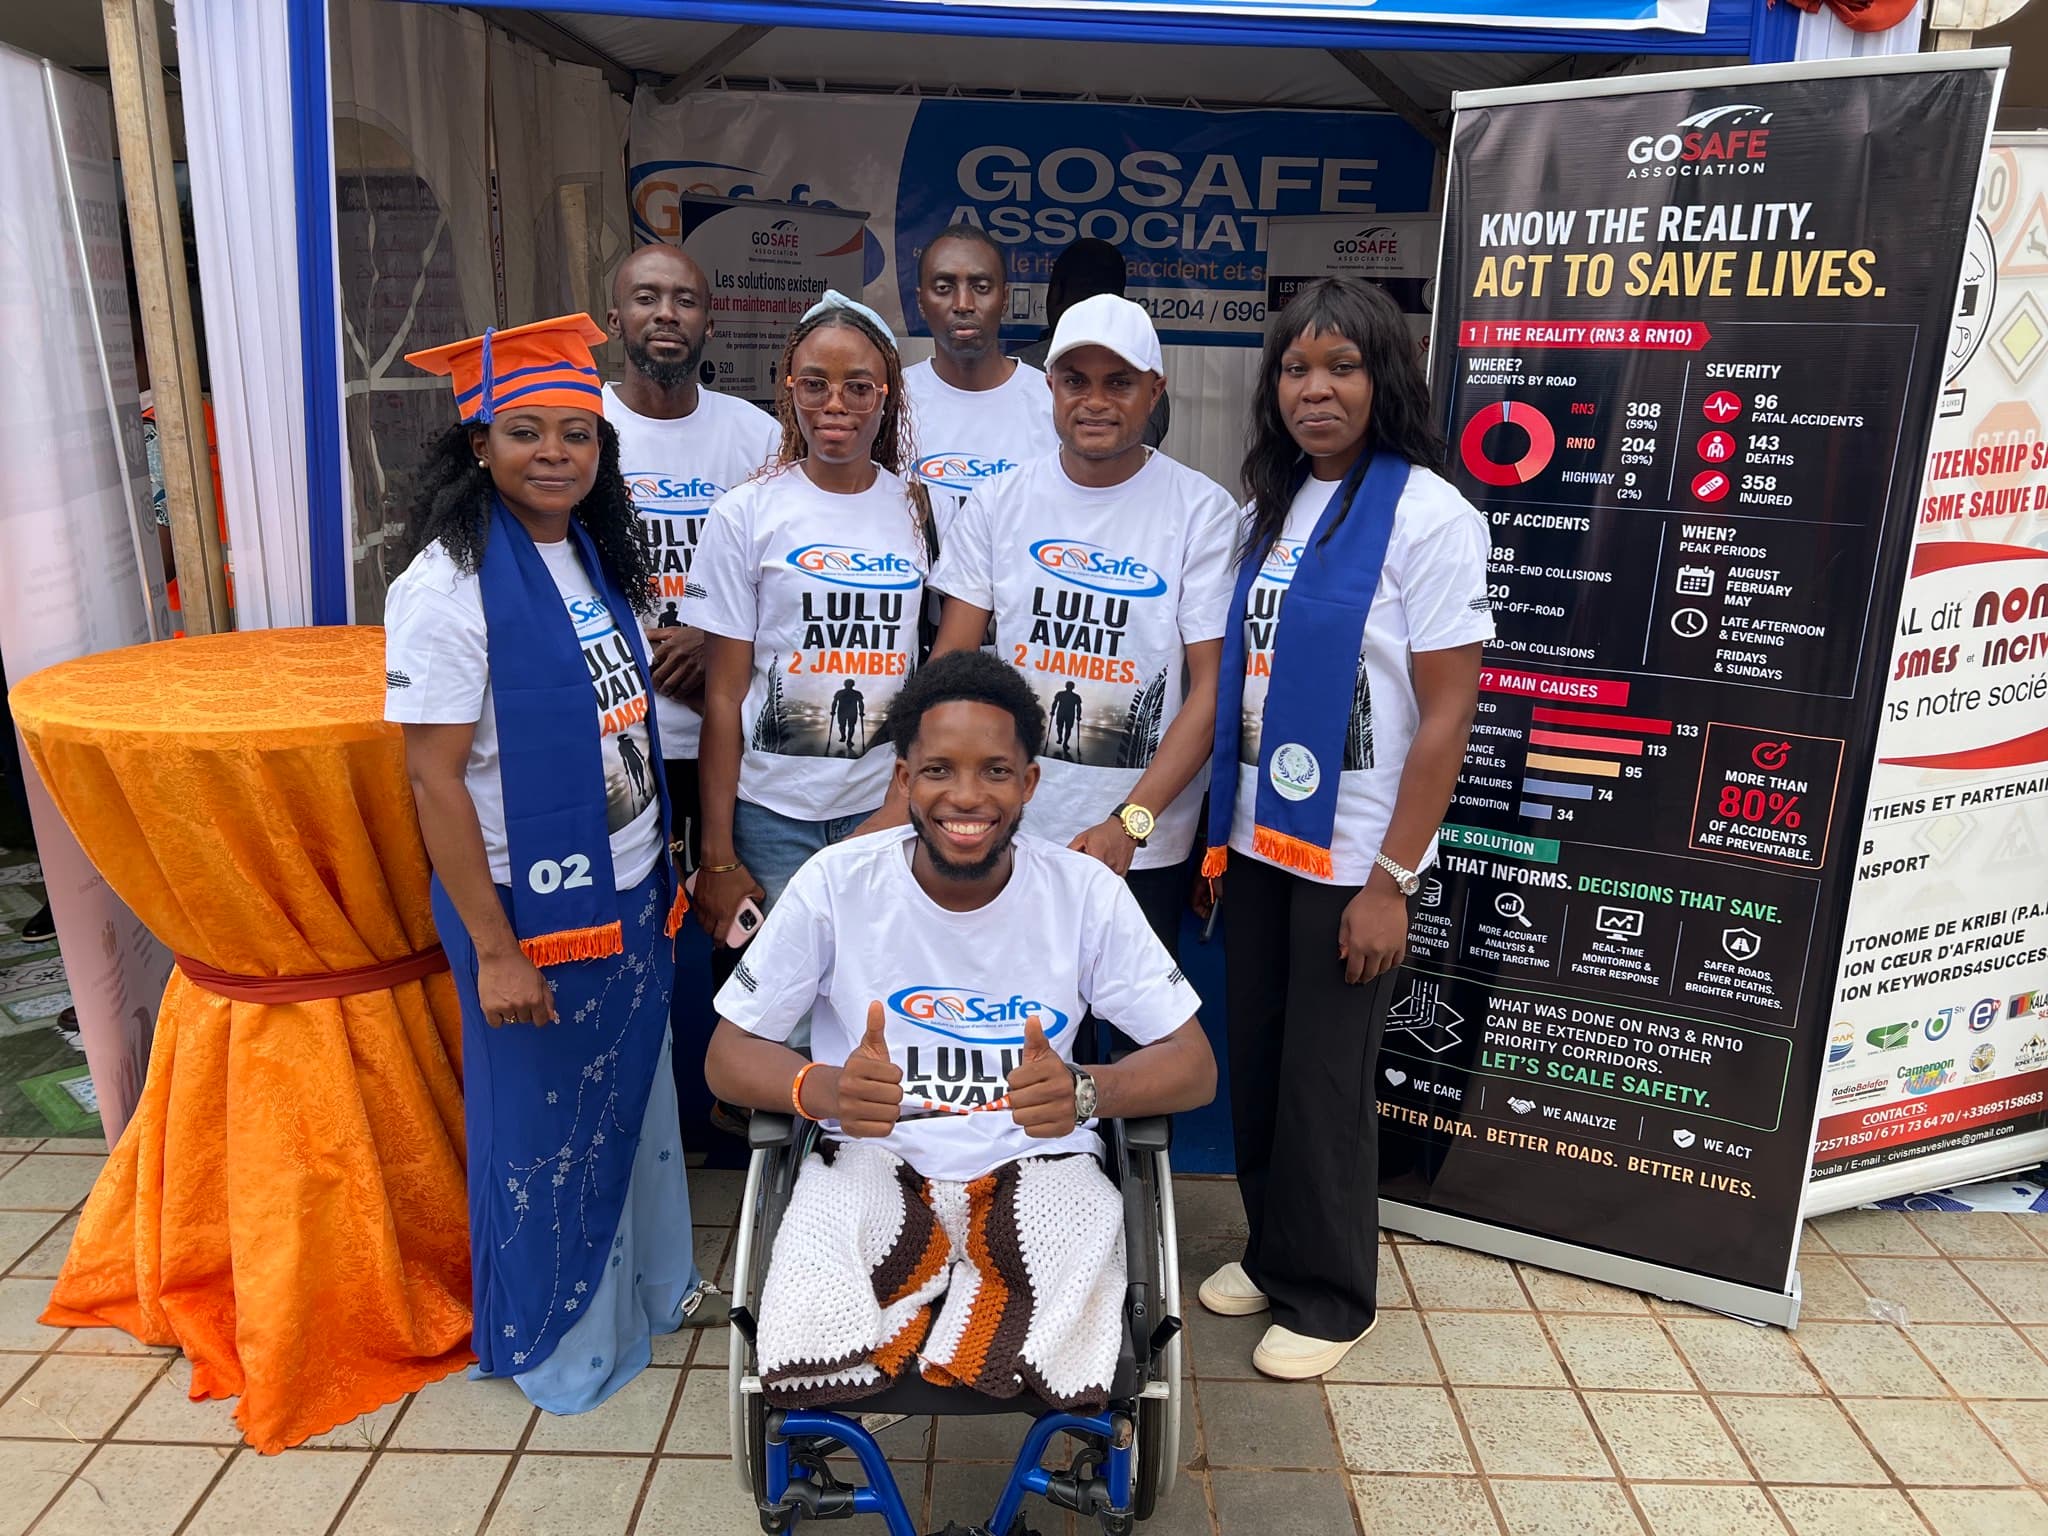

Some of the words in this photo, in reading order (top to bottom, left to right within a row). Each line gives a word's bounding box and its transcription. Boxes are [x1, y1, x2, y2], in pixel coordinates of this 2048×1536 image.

[1627, 129, 1768, 162] GOSAFE
[957, 146, 1378, 213] GOSAFE
[1627, 162, 1766, 179] ASSOCIATION
[1480, 210, 1577, 247] KNOW
[1586, 207, 1650, 244] THE
[1657, 202, 1816, 242] REALITY.
[752, 232, 798, 248] GOSAFE
[1334, 240, 1397, 253] GOSAFE
[716, 270, 734, 289] Les
[738, 272, 785, 291] solutions
[788, 275, 827, 293] existent
[1473, 255, 1553, 298] ACT
[1565, 253, 1615, 297] TO
[1625, 252, 1737, 297] SAVE
[1746, 249, 1886, 298] LIVES.
[1280, 282, 1294, 292] LES
[733, 296, 786, 313] maintenant
[789, 298, 801, 313] les
[1224, 301, 1265, 321] 696
[1496, 327, 1523, 343] THE
[1527, 327, 1585, 343] REALITY
[1590, 327, 1626, 345] (RN3
[1630, 328, 1641, 343] &
[1645, 327, 1693, 345] RN10)
[720, 362, 733, 374] 520
[1469, 358, 1522, 373] WHERE?
[1706, 363, 1781, 380] SEVERITY
[1467, 374, 1524, 386] ACCIDENTS
[1528, 376, 1542, 387] BY
[1546, 376, 1577, 388] ROAD
[1571, 403, 1595, 415] RN3
[1626, 403, 1661, 418] 308
[1754, 395, 1778, 410] 96
[1626, 418, 1657, 431] (59%)
[1752, 412, 1788, 426] FATAL
[1792, 413, 1864, 429] ACCIDENTS
[1567, 437, 1595, 450] RN10
[1621, 437, 1656, 453] 204
[1748, 436, 1779, 451] 143
[1621, 453, 1653, 466] (39%)
[1745, 453, 1794, 467] DEATHS
[1562, 471, 1616, 486] HIGHWAY
[1741, 474, 1777, 491] 358
[1739, 492, 1793, 507] INJURED
[1969, 486, 2031, 518] SAUVE
[1682, 525, 1736, 542] WHEN?
[1680, 542, 1711, 555] PEAK
[1713, 545, 1767, 559] PERIODS
[1486, 563, 1542, 576] REAR-END
[1546, 568, 1612, 583] COLLISIONS
[1728, 567, 1780, 582] AUGUST
[1726, 581, 1792, 598] FEBRUARY
[802, 592, 902, 622] LULU
[1032, 586, 1130, 629] LULU
[1931, 602, 1962, 631] dit
[802, 624, 901, 649] AVAIT
[1029, 619, 1126, 656] AVAIT
[1721, 617, 1749, 629] LATE
[1752, 619, 1825, 637] AFTERNOON
[1731, 631, 1784, 647] EVENING
[788, 652, 802, 674] 2
[810, 651, 907, 675] JAMBES
[1014, 644, 1027, 667] 2
[1035, 649, 1140, 684] JAMBES.
[1716, 649, 1767, 665] FRIDAYS
[1894, 644, 1960, 681] SMES
[1966, 654, 1975, 663] et
[1726, 664, 1783, 681] SUNDAYS
[1500, 675, 1536, 691] MAIN
[1540, 680, 1598, 698] CAUSES
[1916, 688, 1980, 717] notre
[1725, 770, 1765, 786] MORE
[1769, 775, 1808, 793] THAN
[1718, 786, 1800, 829] 80%
[1464, 832, 1535, 855] SOLUTION
[1709, 819, 1727, 832] OF
[1730, 821, 1807, 846] ACCIDENTS
[1700, 833, 1724, 846] ARE
[1726, 836, 1813, 861] PREVENTABLE.
[527, 853, 593, 895] 02
[1858, 855, 1929, 881] NSPORT
[1447, 855, 1488, 875] THAT
[1492, 863, 1572, 890] INFORMS.
[1578, 876, 1673, 905] DECISIONS
[1679, 890, 1725, 911] THAT
[1730, 897, 1782, 924] SAVE.
[1479, 924, 1501, 936] MORE
[1503, 929, 1548, 943] ACCURATE
[1934, 921, 1956, 938] DE
[1961, 910, 2007, 933] KRIBI
[1485, 938, 1525, 952] ANALYSIS
[1592, 942, 1644, 958] REAL-TIME
[1881, 948, 1932, 971] CŒUR
[1938, 929, 2026, 960] D'AFRIQUE
[1470, 947, 1500, 960] BETTER
[1502, 953, 1550, 968] TARGETING
[1582, 953, 1642, 970] MONITORING
[1571, 964, 1606, 979] FASTER
[1608, 969, 1659, 986] RESPONSE
[1704, 960, 1734, 974] SAFER
[1736, 966, 1773, 982] ROADS.
[1698, 972, 1731, 987] FEWER
[1734, 977, 1774, 995] DEATHS.
[1685, 983, 1733, 1002] BRIGHTER
[1735, 993, 1782, 1010] FUTURES.
[1488, 997, 1528, 1015] WHAT
[1532, 1003, 1567, 1021] WAS
[1571, 1010, 1616, 1029] DONE
[1619, 1017, 1642, 1033] ON
[1648, 1022, 1679, 1040] RN3
[1685, 1029, 1696, 1042] &
[1702, 1032, 1743, 1053] RN10
[1486, 1015, 1517, 1031] CAN
[1522, 1021, 1542, 1035] BE
[1546, 1024, 1628, 1049] EXTENDED
[1635, 1038, 1654, 1052] TO
[1658, 1042, 1711, 1066] OTHER
[1484, 1032, 1557, 1053] PRIORITY
[1561, 1043, 1664, 1075] CORRIDORS.
[1896, 1058, 1955, 1079] Cameroon
[1413, 1080, 1431, 1094] WE
[1433, 1082, 1462, 1100] CARE
[1481, 1051, 1539, 1075] LET'S
[1546, 1061, 1615, 1090] SCALE
[1621, 1075, 1710, 1109] SAFETY.
[1831, 1078, 1889, 1097] RadioBalafon
[1862, 1103, 1928, 1126] CONTACTS:
[1961, 1091, 2044, 1120] +33695158683
[1543, 1105, 1561, 1118] WE
[1563, 1109, 1617, 1131] ANALYZE
[1376, 1100, 1428, 1128] BETTER
[1433, 1116, 1478, 1139] DATA.
[1486, 1128, 1548, 1153] BETTER
[1555, 1141, 1618, 1168] ROADS.
[1627, 1156, 1694, 1185] BETTER
[1700, 1171, 1756, 1199] LIVES.
[1704, 1138, 1721, 1153] WE
[1724, 1142, 1752, 1160] ACT
[1810, 1164, 1842, 1179] Douala
[1851, 1155, 1880, 1170] E-mail
[1888, 1124, 2014, 1162] civismsaveslives@gmail.com
